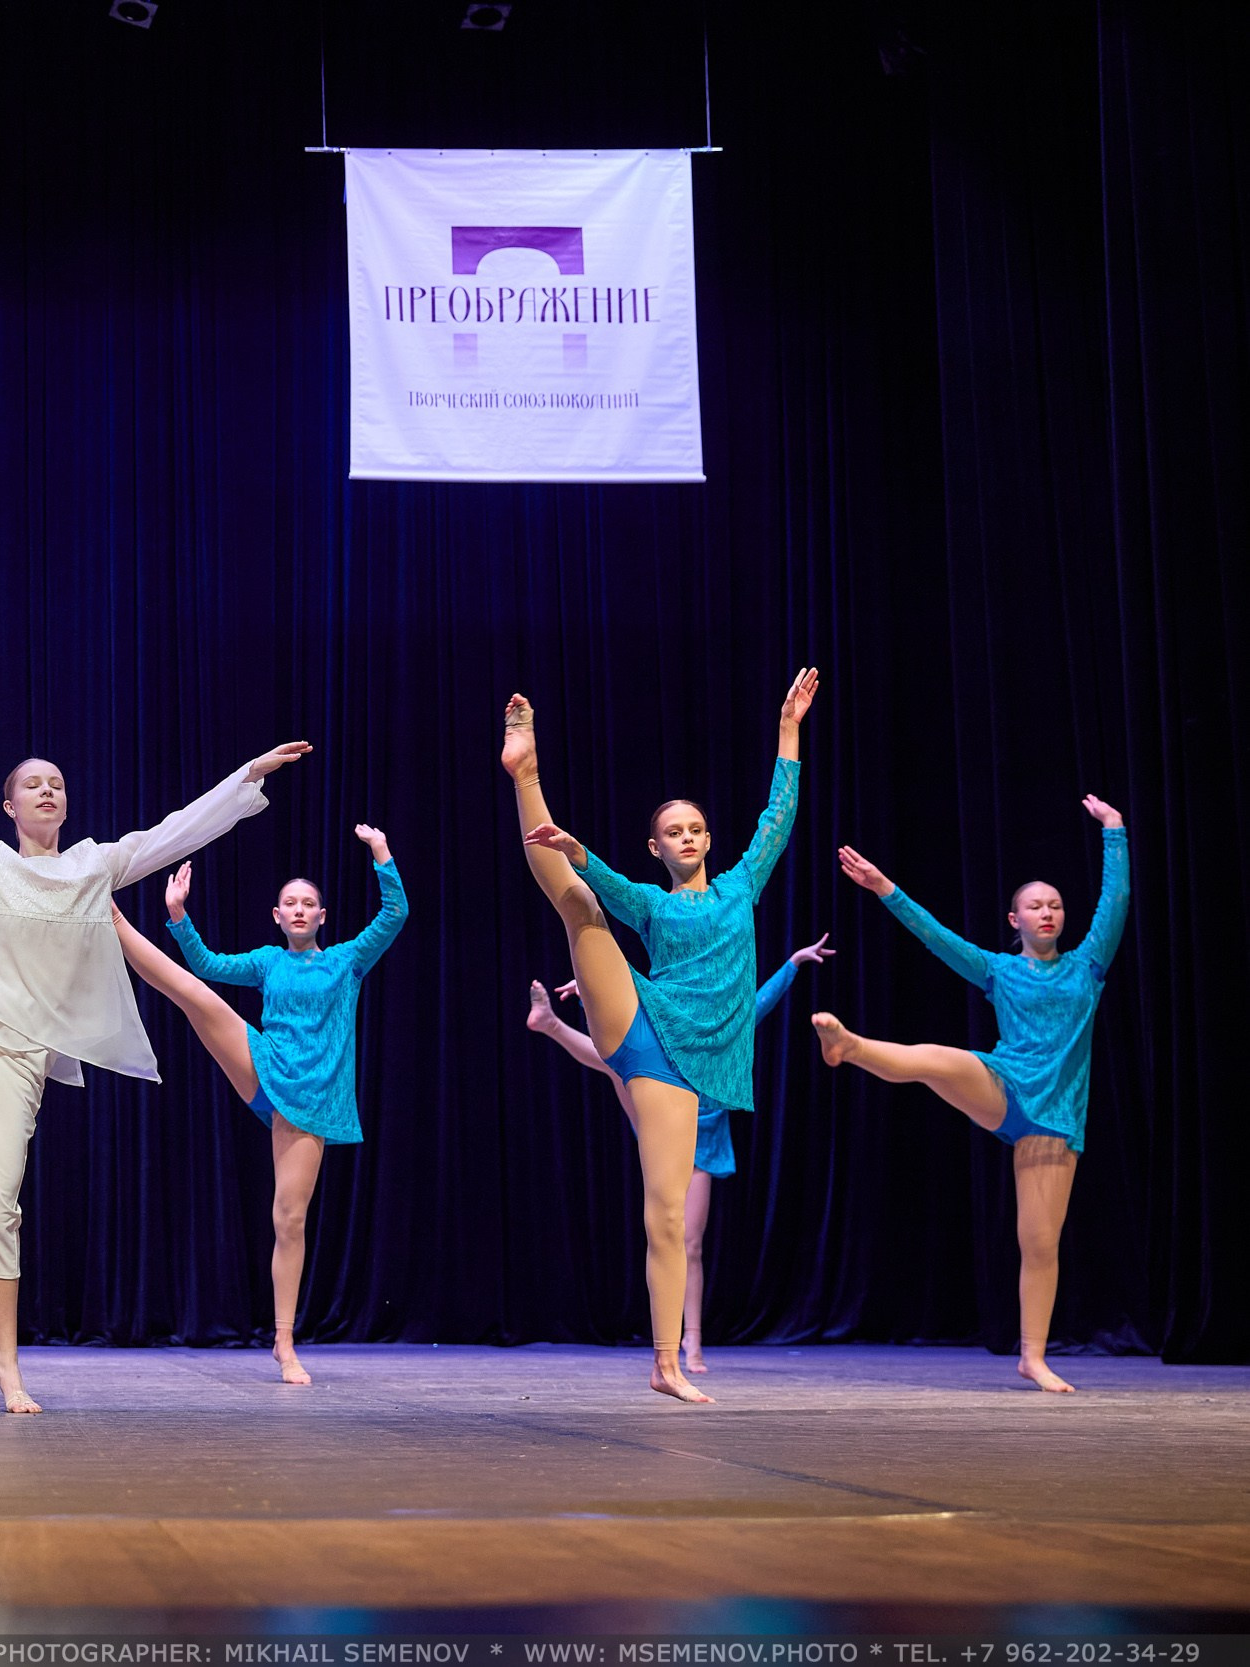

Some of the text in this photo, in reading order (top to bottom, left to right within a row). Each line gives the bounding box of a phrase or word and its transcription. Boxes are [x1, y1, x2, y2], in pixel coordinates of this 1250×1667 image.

[384, 285, 661, 324] ПРЕОБРАЖЕНИЕ
[408, 389, 639, 409] ТВОРЧЕСКИЙ СОЮЗ ПОКОЛЕНИЙ
